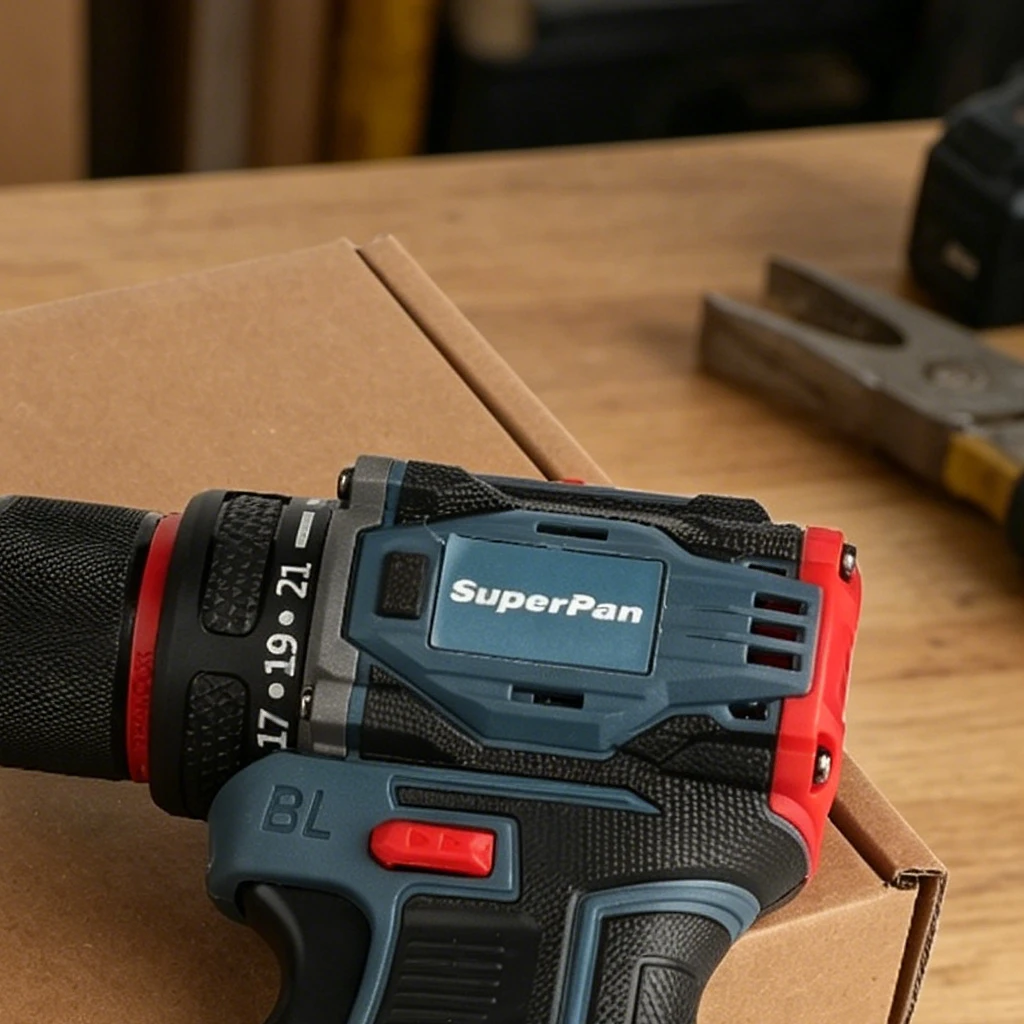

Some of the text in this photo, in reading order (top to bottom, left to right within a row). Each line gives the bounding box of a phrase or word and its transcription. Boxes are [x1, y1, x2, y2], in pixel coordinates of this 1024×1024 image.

[449, 578, 644, 624] SuperPan
[257, 562, 311, 749] 17 19 21
[261, 784, 331, 840] BL
